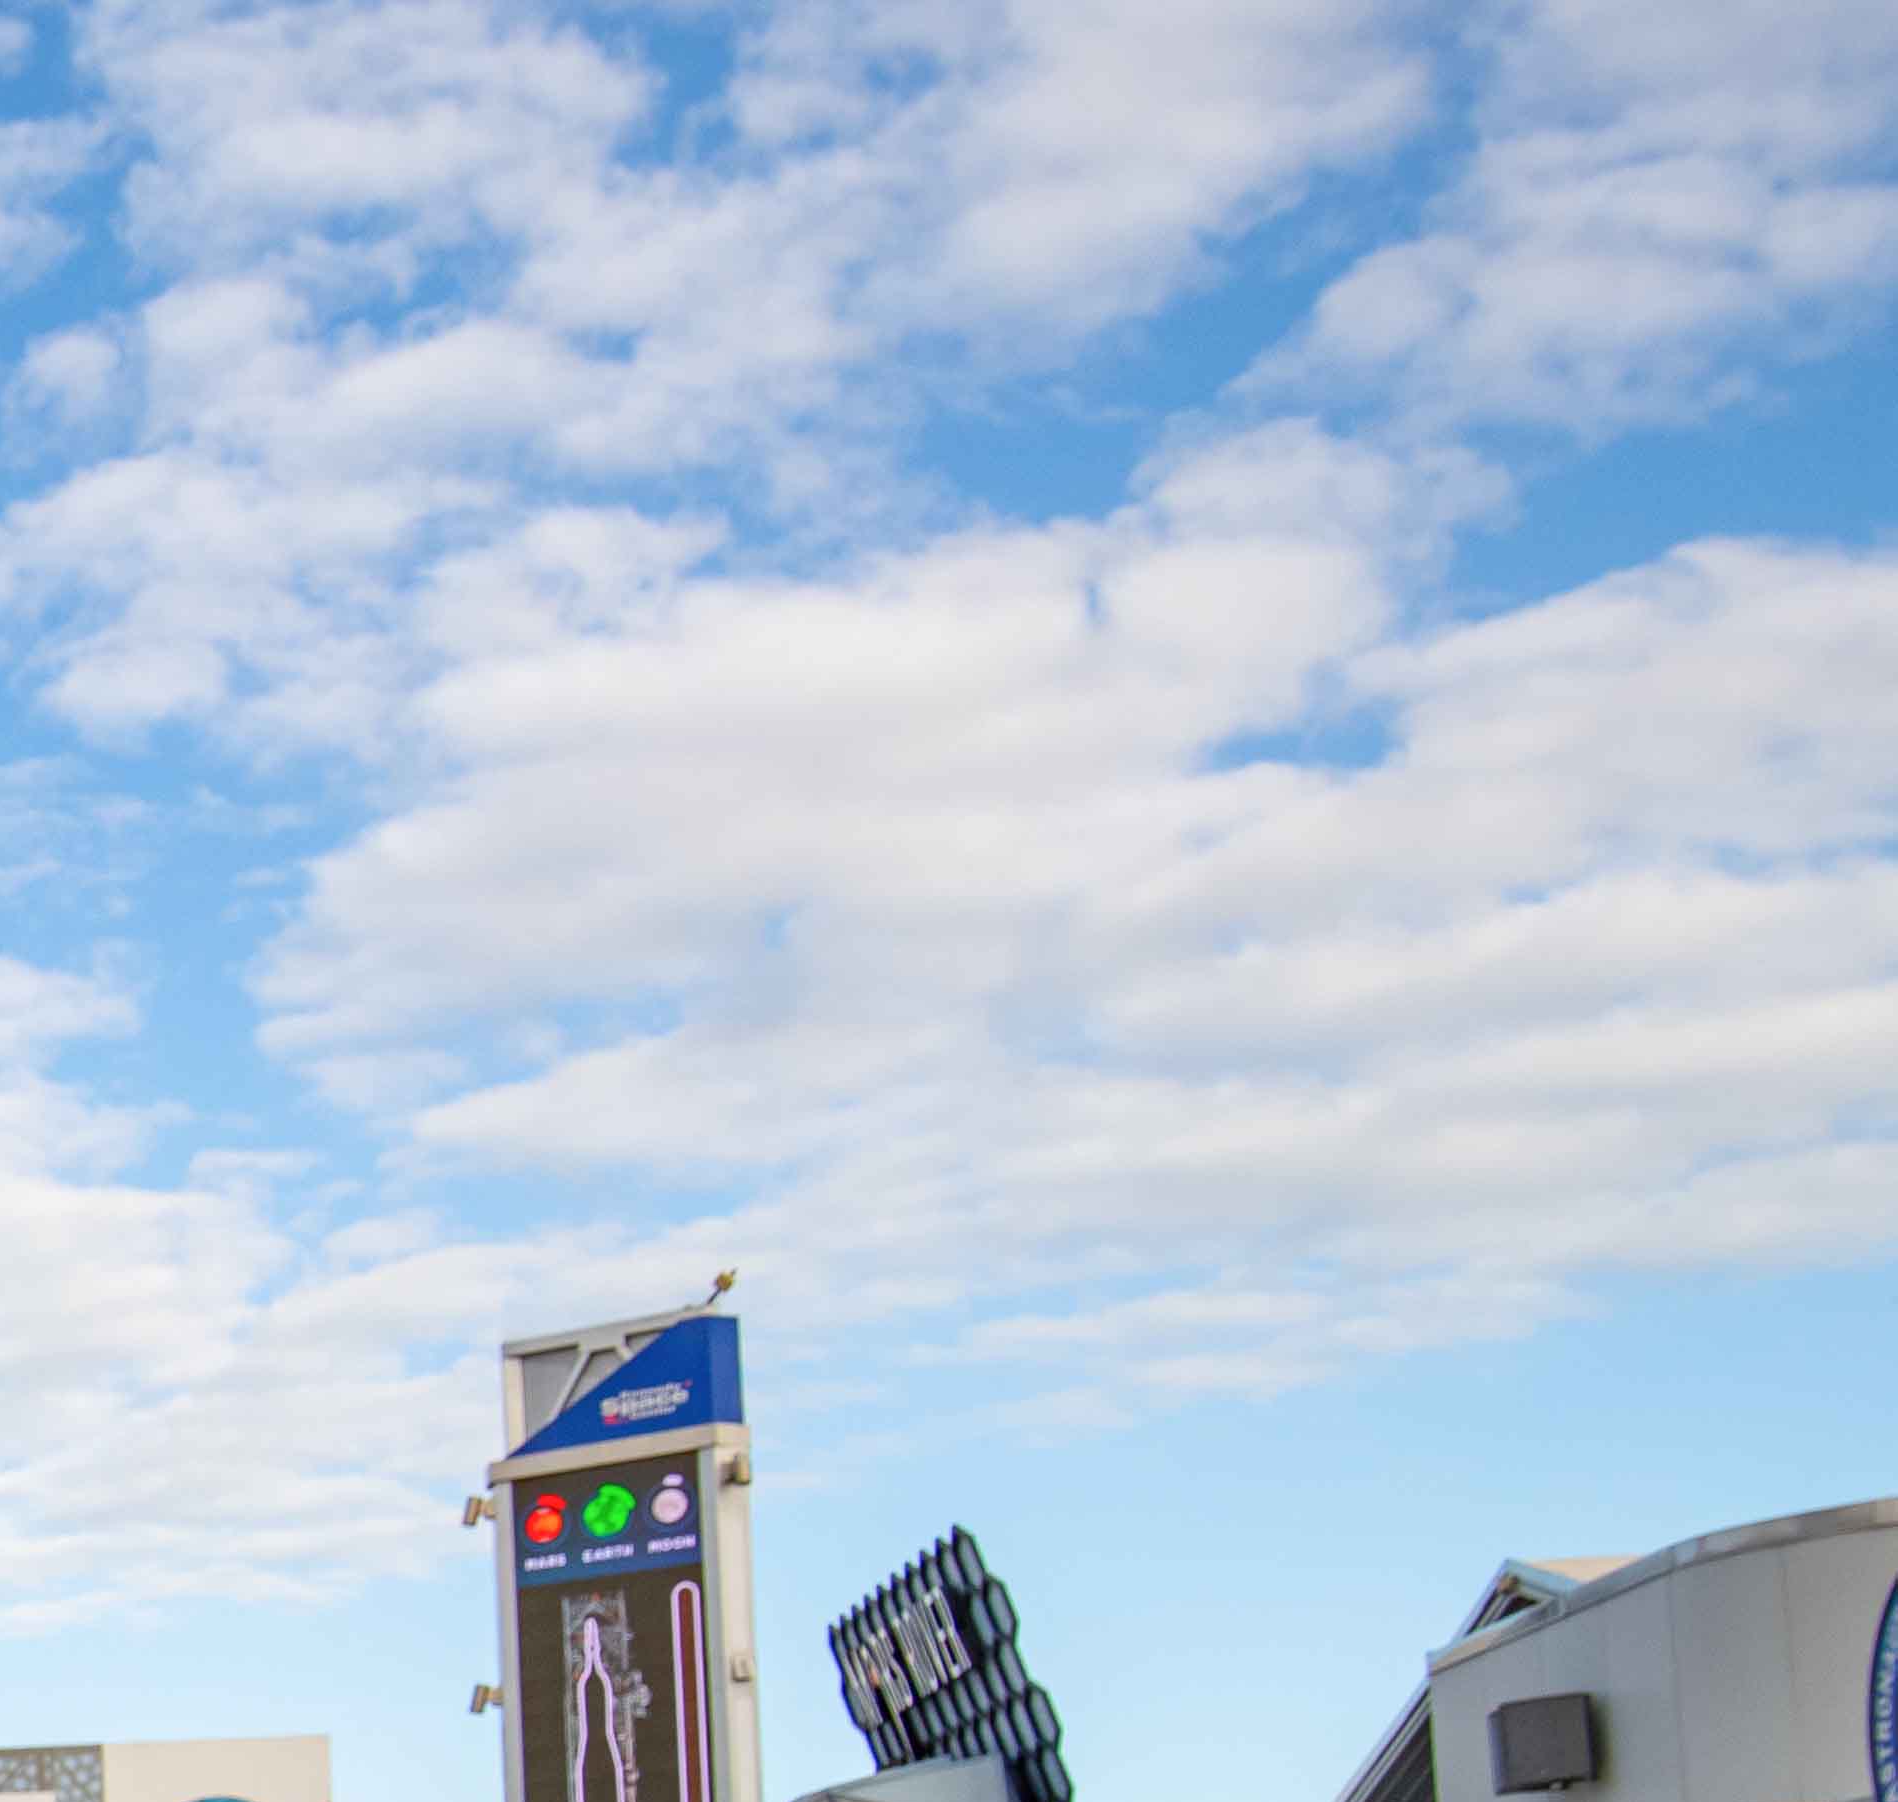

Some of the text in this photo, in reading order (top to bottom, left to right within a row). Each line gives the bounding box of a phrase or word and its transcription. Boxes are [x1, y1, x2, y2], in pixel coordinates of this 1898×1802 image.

[524, 1534, 696, 1572] MARS EARTH MOON
